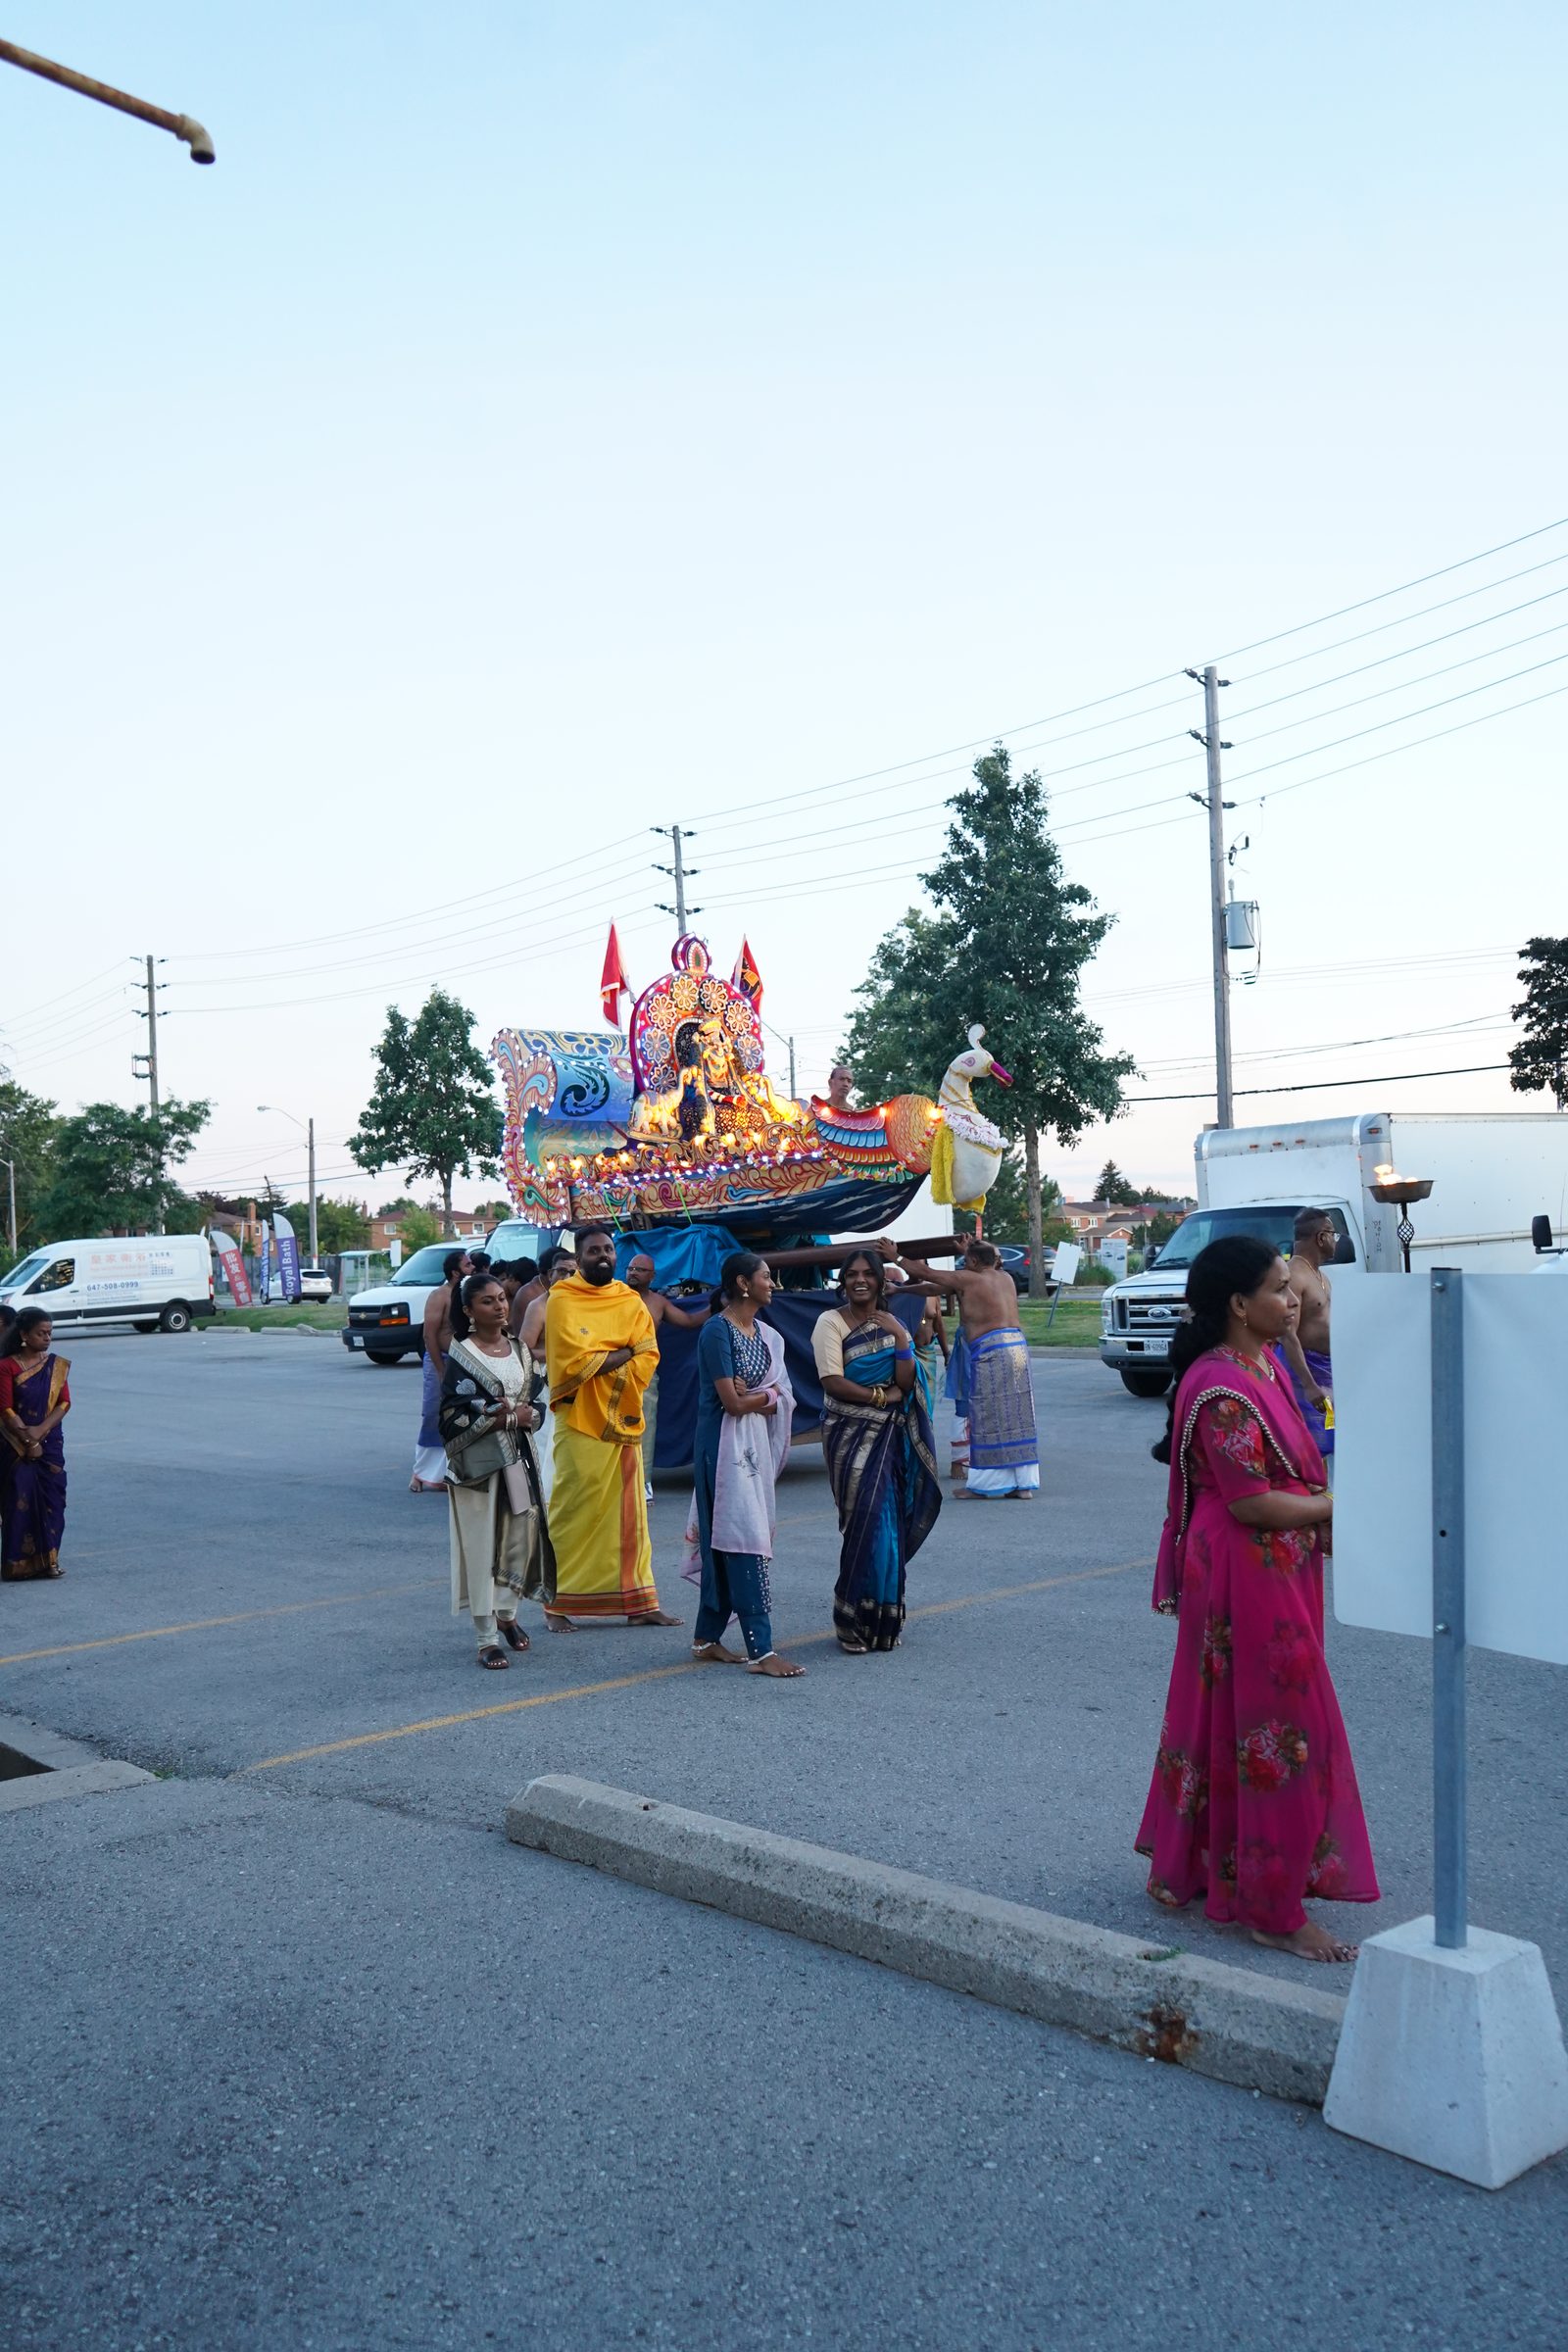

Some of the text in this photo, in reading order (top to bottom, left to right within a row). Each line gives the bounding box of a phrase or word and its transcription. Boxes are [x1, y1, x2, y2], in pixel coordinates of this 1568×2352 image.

[280, 1240, 296, 1295] Royal Bath
[86, 1281, 139, 1292] 647-508-0999
